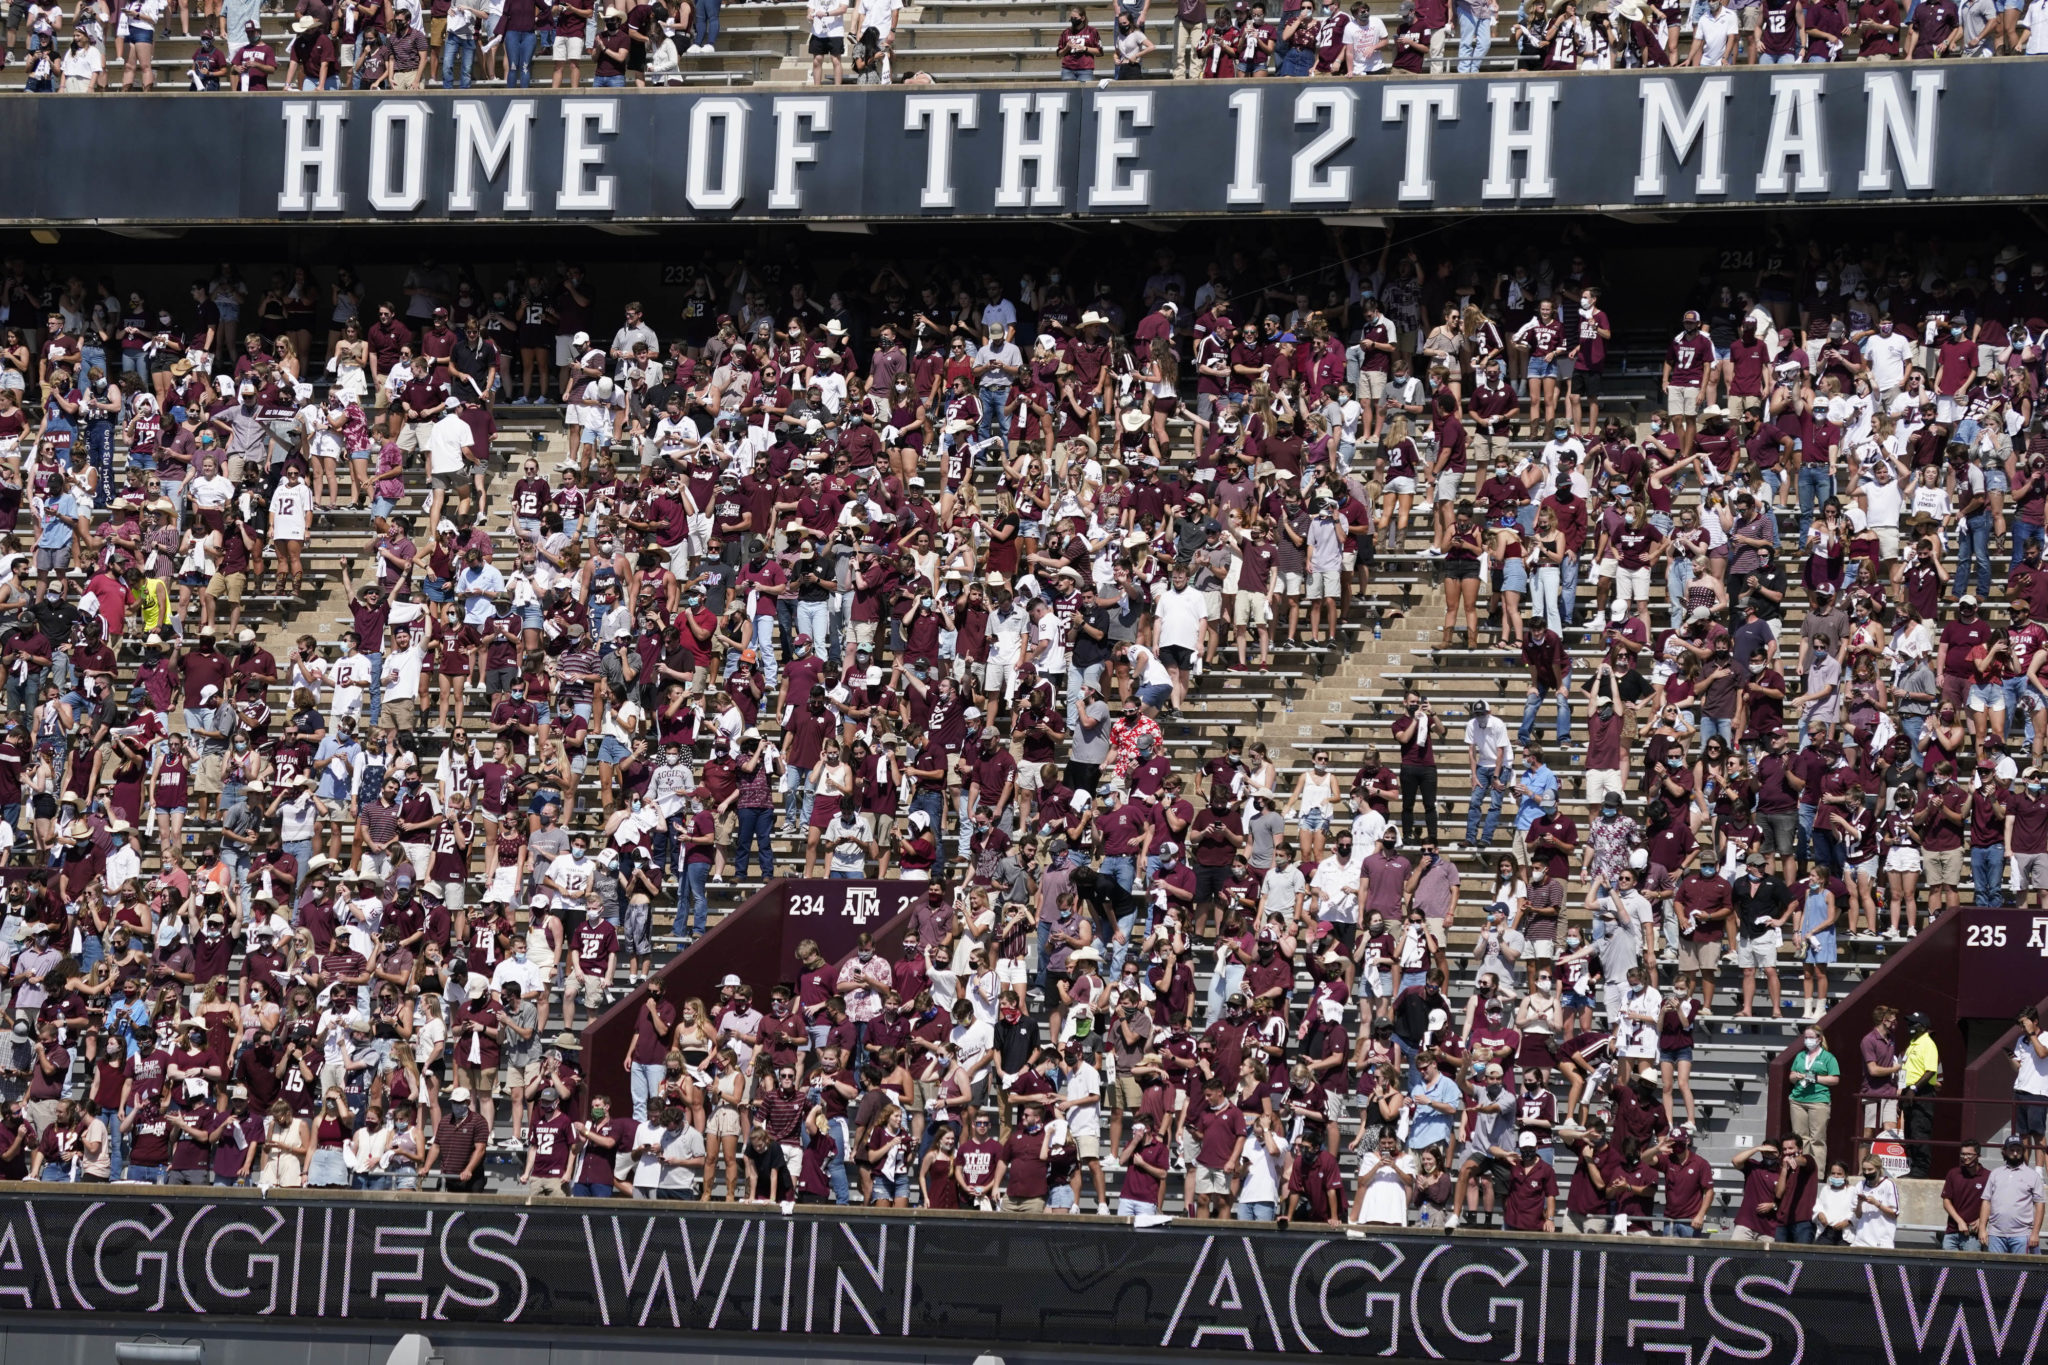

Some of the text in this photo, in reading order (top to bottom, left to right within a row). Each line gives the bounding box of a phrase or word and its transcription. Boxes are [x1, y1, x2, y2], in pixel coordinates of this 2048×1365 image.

[1769, 16, 1786, 33] 12
[1320, 28, 1333, 47] 12
[1553, 37, 1574, 63] 12
[278, 70, 1947, 212] HOME OF THE 12TH MAN
[1720, 251, 1753, 270] 234
[525, 306, 543, 325] 12
[1536, 333, 1552, 350] 12
[790, 350, 801, 363] 12
[1678, 351, 1696, 369] 17
[44, 433, 70, 443] YLAN
[137, 430, 156, 446] 12
[1123, 450, 1139, 466] 12
[1388, 448, 1402, 467] 12
[947, 460, 962, 479] 12
[278, 499, 295, 516] 12
[520, 495, 538, 514] 12
[447, 640, 456, 652] 12
[337, 666, 353, 685] 12
[929, 711, 945, 730] 12
[276, 764, 295, 788] 12
[452, 767, 469, 792] 12
[656, 769, 687, 782] AGGIES
[437, 833, 456, 854] 12
[1081, 829, 1093, 844] 12
[567, 873, 583, 891] 12
[789, 895, 825, 916] 234
[476, 931, 493, 949] 12
[1966, 925, 2007, 947] 235
[581, 939, 600, 959] 12
[285, 1069, 305, 1092] 15
[1522, 1106, 1540, 1120] 12
[55, 1131, 79, 1152] 12
[536, 1133, 555, 1155] 12
[582, 1214, 917, 1337] WIN
[1160, 1235, 1806, 1365] AGGIES
